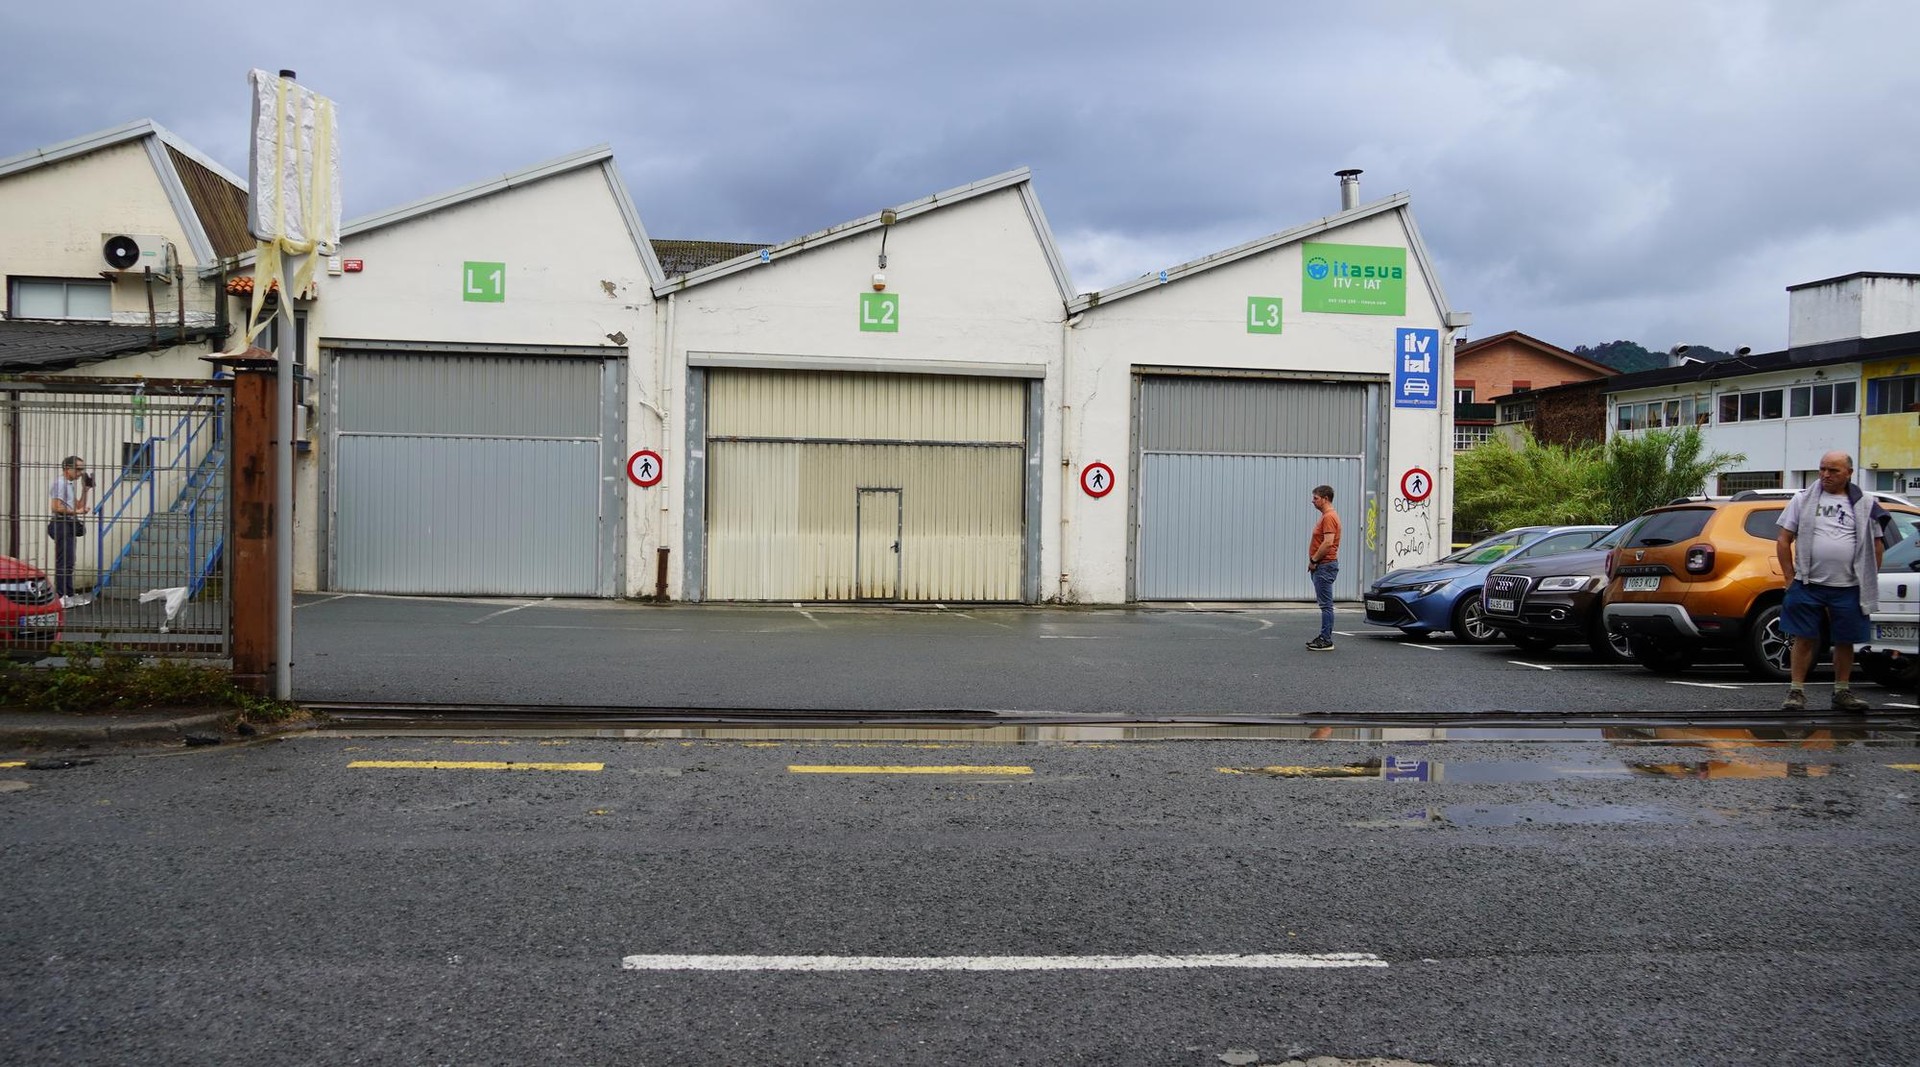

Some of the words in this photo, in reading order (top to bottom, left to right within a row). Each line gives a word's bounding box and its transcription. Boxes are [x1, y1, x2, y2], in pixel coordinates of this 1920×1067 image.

[1333, 261, 1402, 279] itasua
[467, 269, 501, 294] L1
[1333, 278, 1352, 288] ITV
[1364, 280, 1381, 290] IAT
[863, 300, 895, 324] L2
[1251, 304, 1279, 327] L3
[1404, 332, 1431, 353] itv
